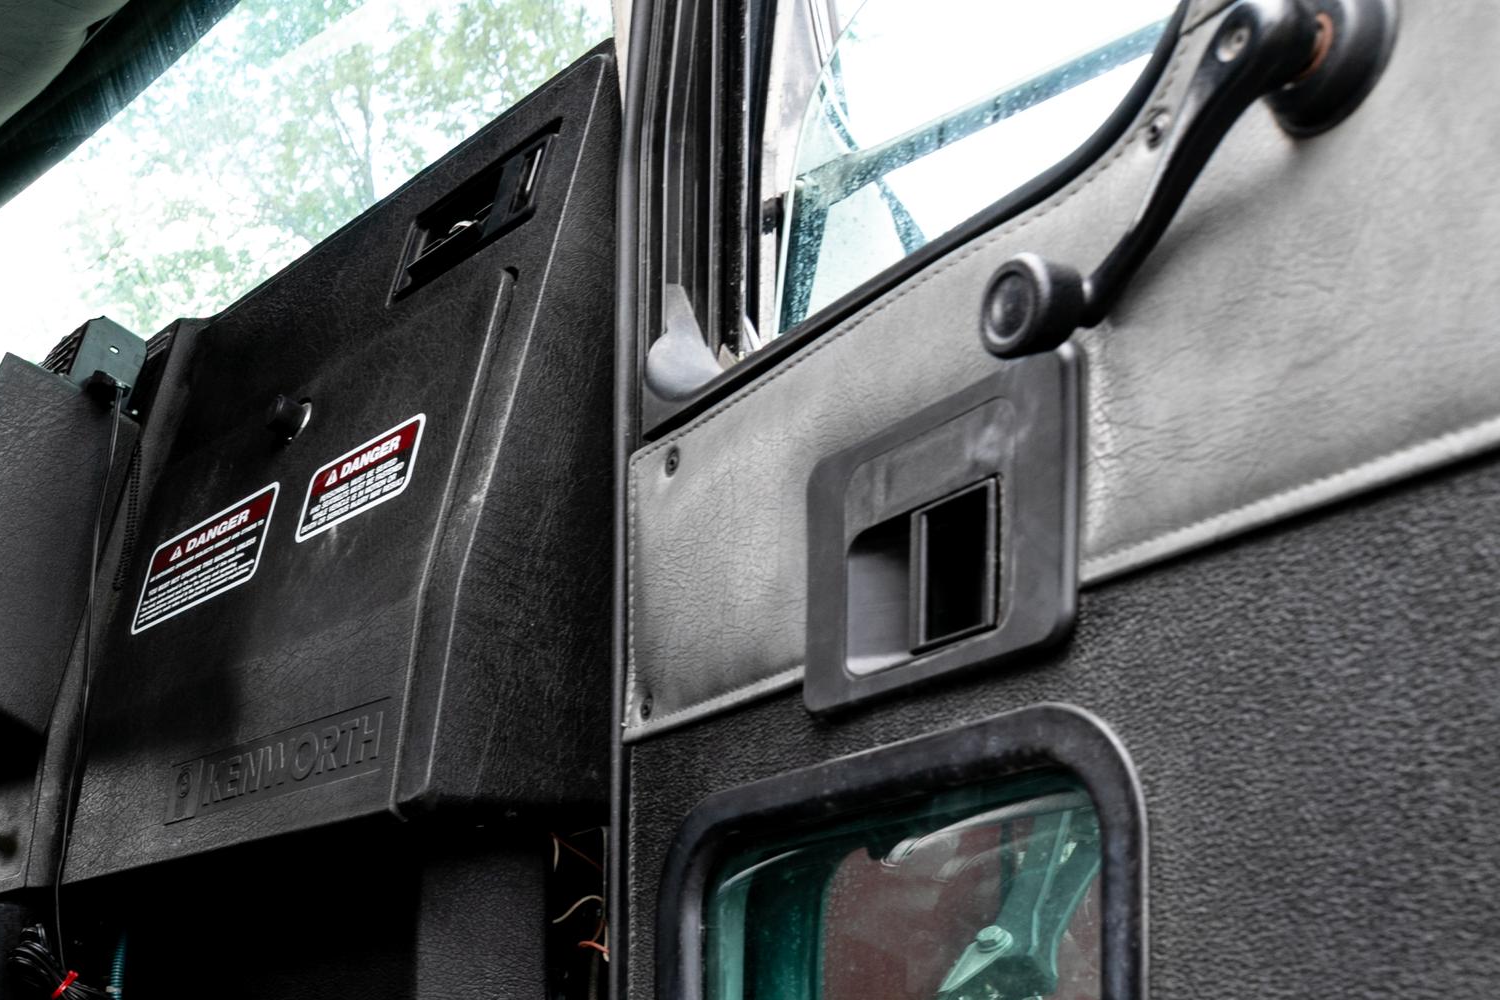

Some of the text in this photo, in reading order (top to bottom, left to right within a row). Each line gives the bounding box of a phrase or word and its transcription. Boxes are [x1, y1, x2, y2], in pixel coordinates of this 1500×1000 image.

[340, 435, 402, 479] DANGER
[185, 509, 251, 553] DANGER
[201, 711, 384, 807] KENWORTH
